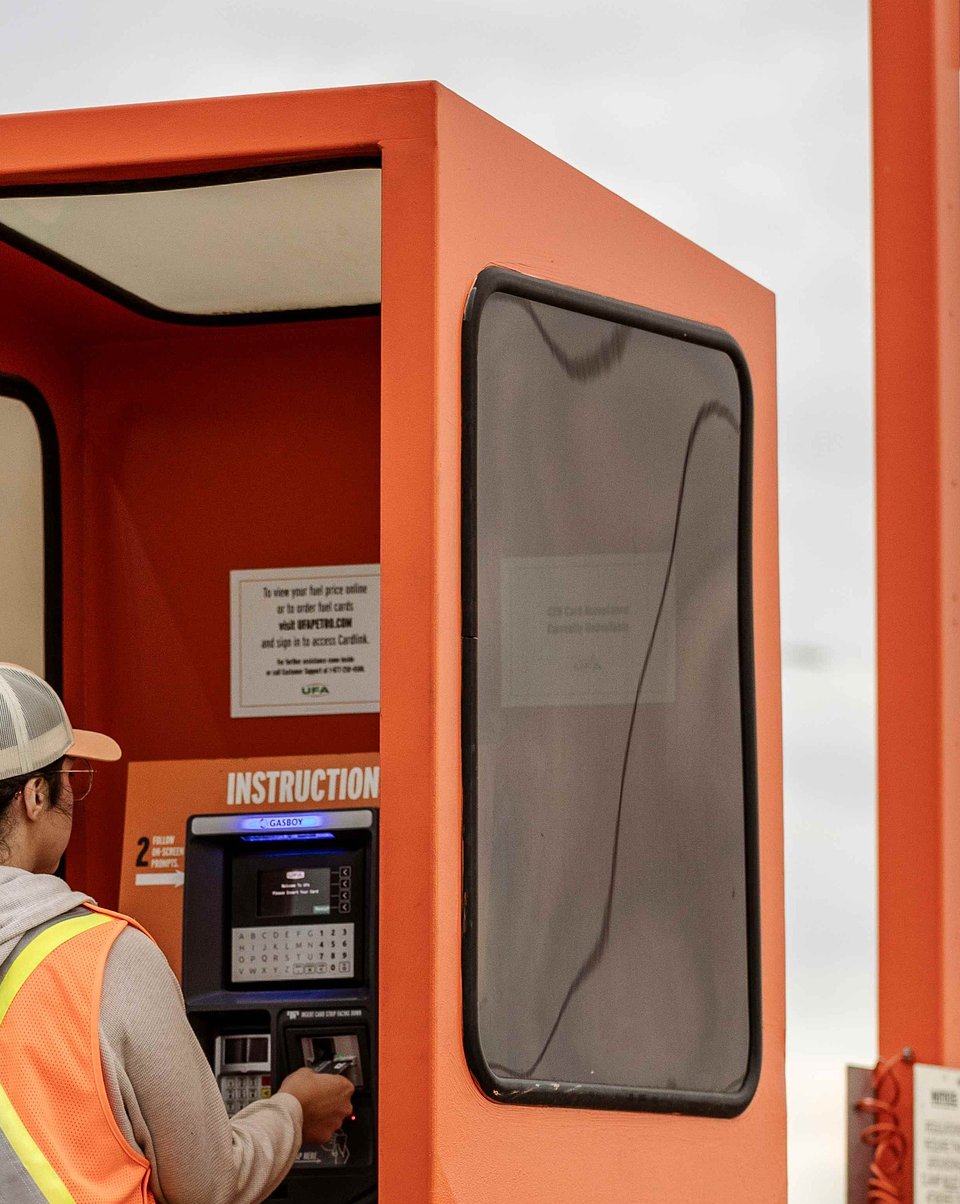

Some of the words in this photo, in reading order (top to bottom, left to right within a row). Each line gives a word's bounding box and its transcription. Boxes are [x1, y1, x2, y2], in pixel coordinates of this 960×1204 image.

[264, 587, 270, 598] To
[274, 587, 289, 598] view
[291, 587, 306, 599] your
[309, 585, 323, 596] fuel
[325, 585, 343, 597] price
[346, 583, 367, 594] online
[277, 606, 284, 614] or
[287, 603, 294, 614] to
[296, 604, 316, 614] order
[318, 602, 332, 613] fuel
[334, 601, 354, 612] cards
[278, 620, 295, 630] visit
[262, 638, 274, 648] and
[276, 637, 291, 650] sign
[294, 637, 300, 646] in
[302, 636, 310, 646] to
[312, 638, 336, 646] access
[338, 634, 370, 645] Cardlink.
[269, 818, 303, 828] GASBOY
[136, 836, 150, 867] 2
[152, 836, 175, 846] FOLLOW
[151, 858, 178, 868] PROMPTS.
